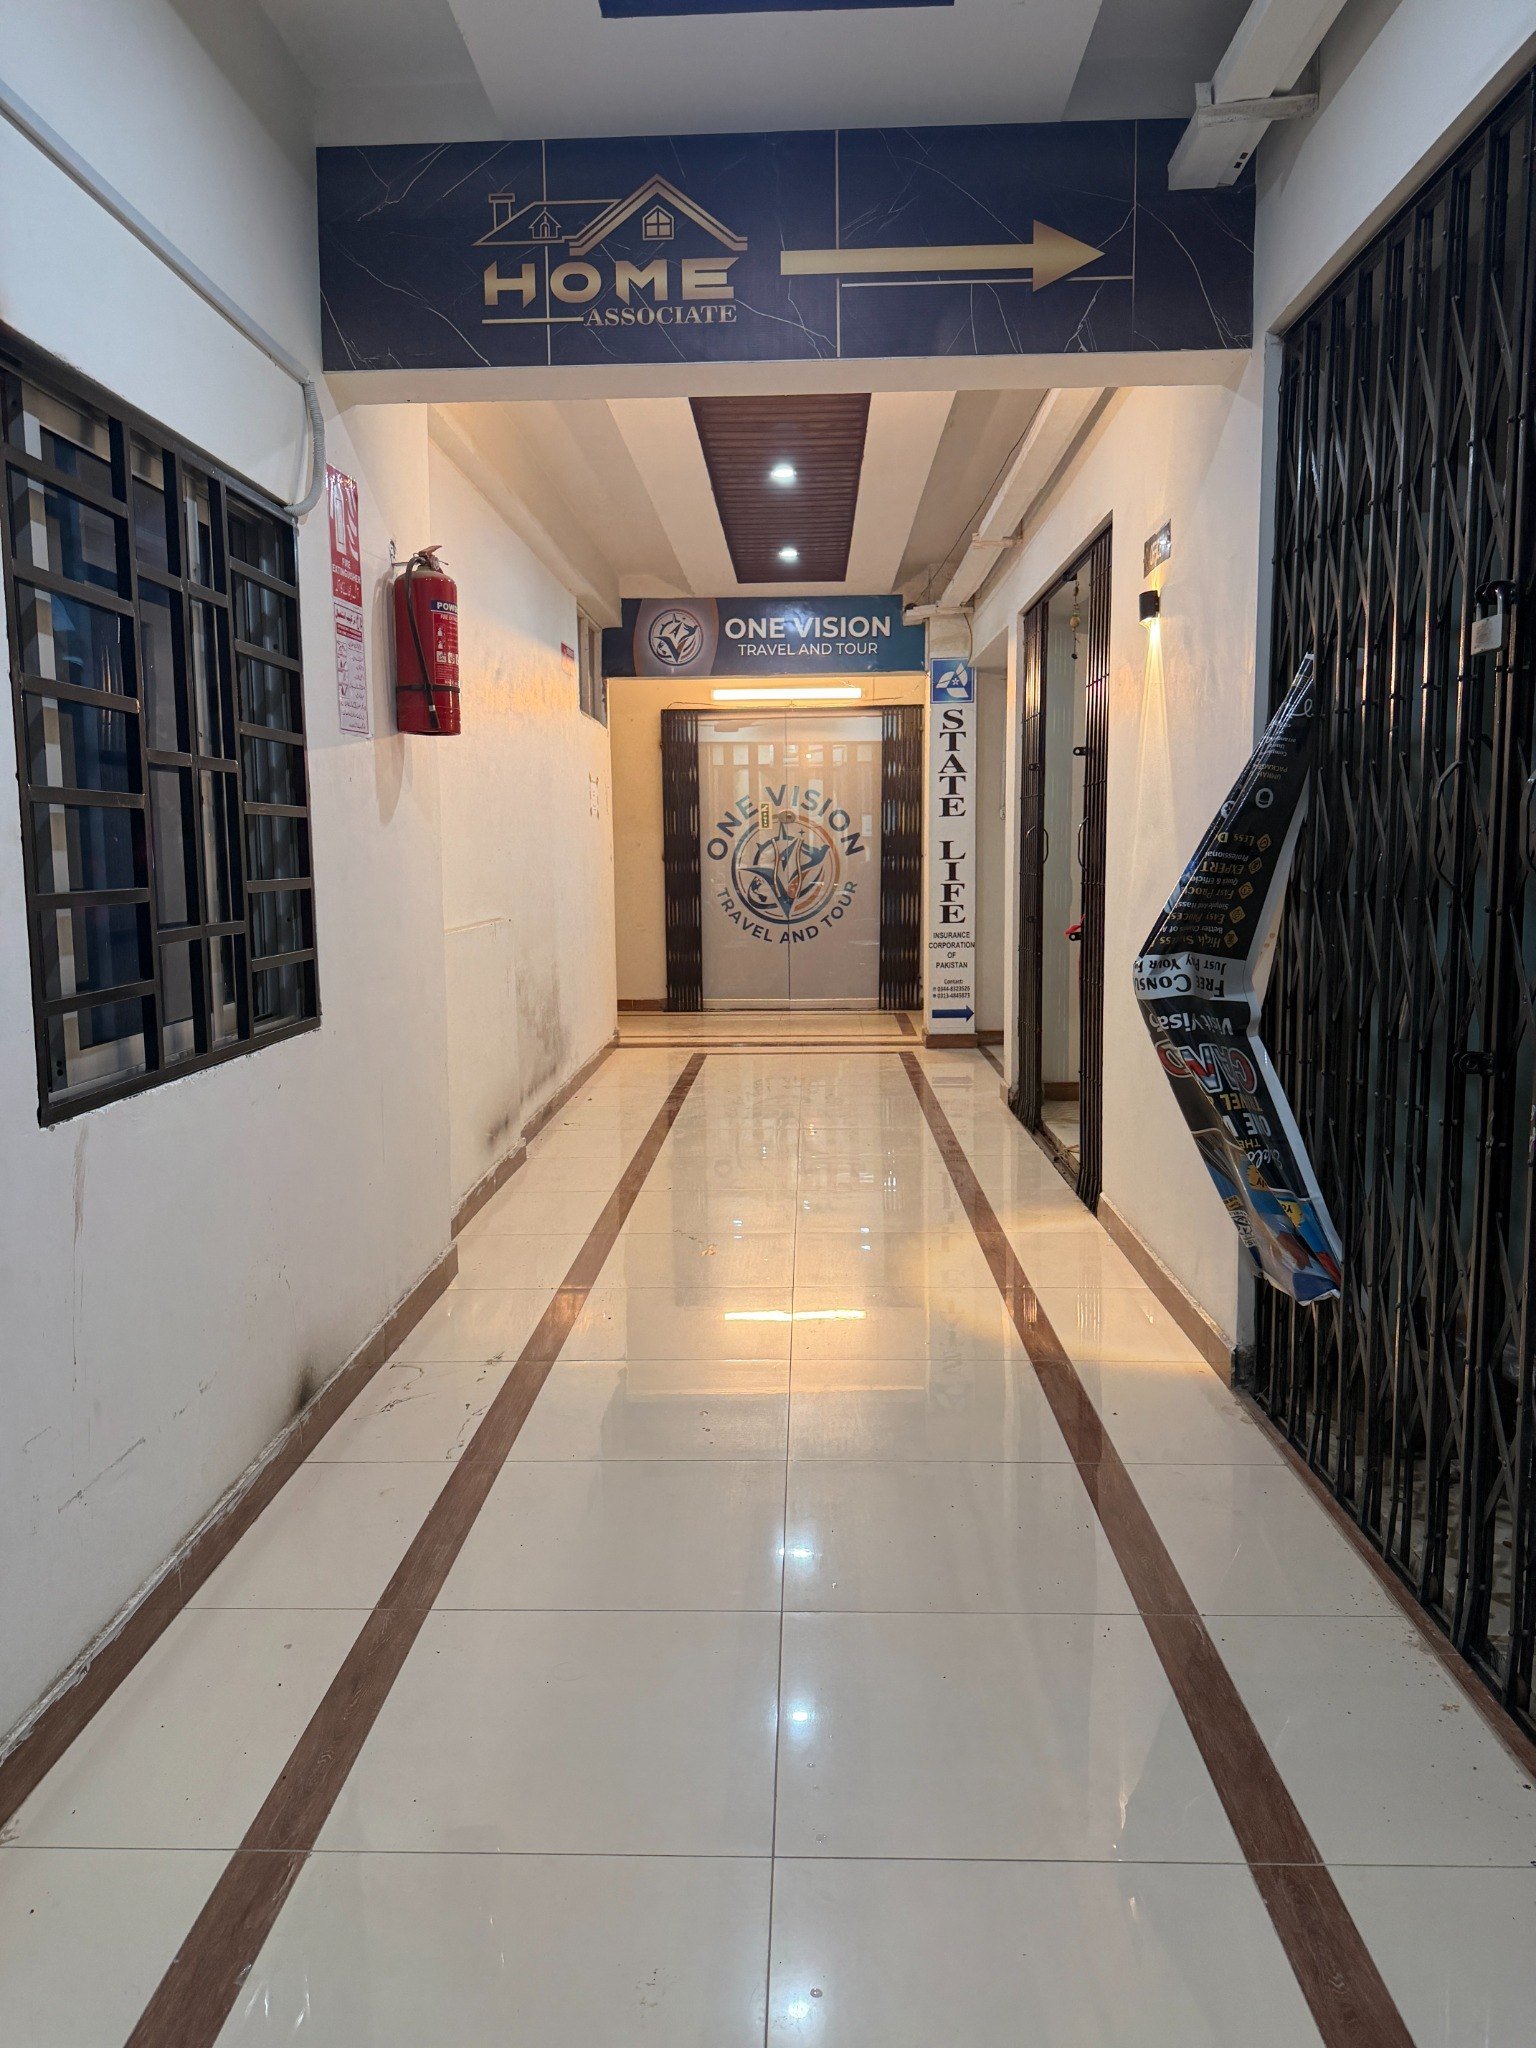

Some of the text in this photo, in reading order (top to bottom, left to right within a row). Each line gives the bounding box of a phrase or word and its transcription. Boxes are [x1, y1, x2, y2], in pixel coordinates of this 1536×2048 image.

[483, 257, 740, 309] HOME
[583, 304, 738, 327] ASSOCIATE
[724, 616, 891, 639] ONE VISION
[738, 642, 878, 657] TRAVEL AND TOUR
[707, 784, 865, 861] ONE VISION
[937, 708, 968, 925] STATE LIFE
[717, 881, 858, 944] TRAVEL AND TOUR
[928, 941, 975, 949] CORPORATION
[947, 951, 956, 959] OF
[935, 961, 968, 969] PAKISTAN
[1195, 975, 1225, 998] FREE
